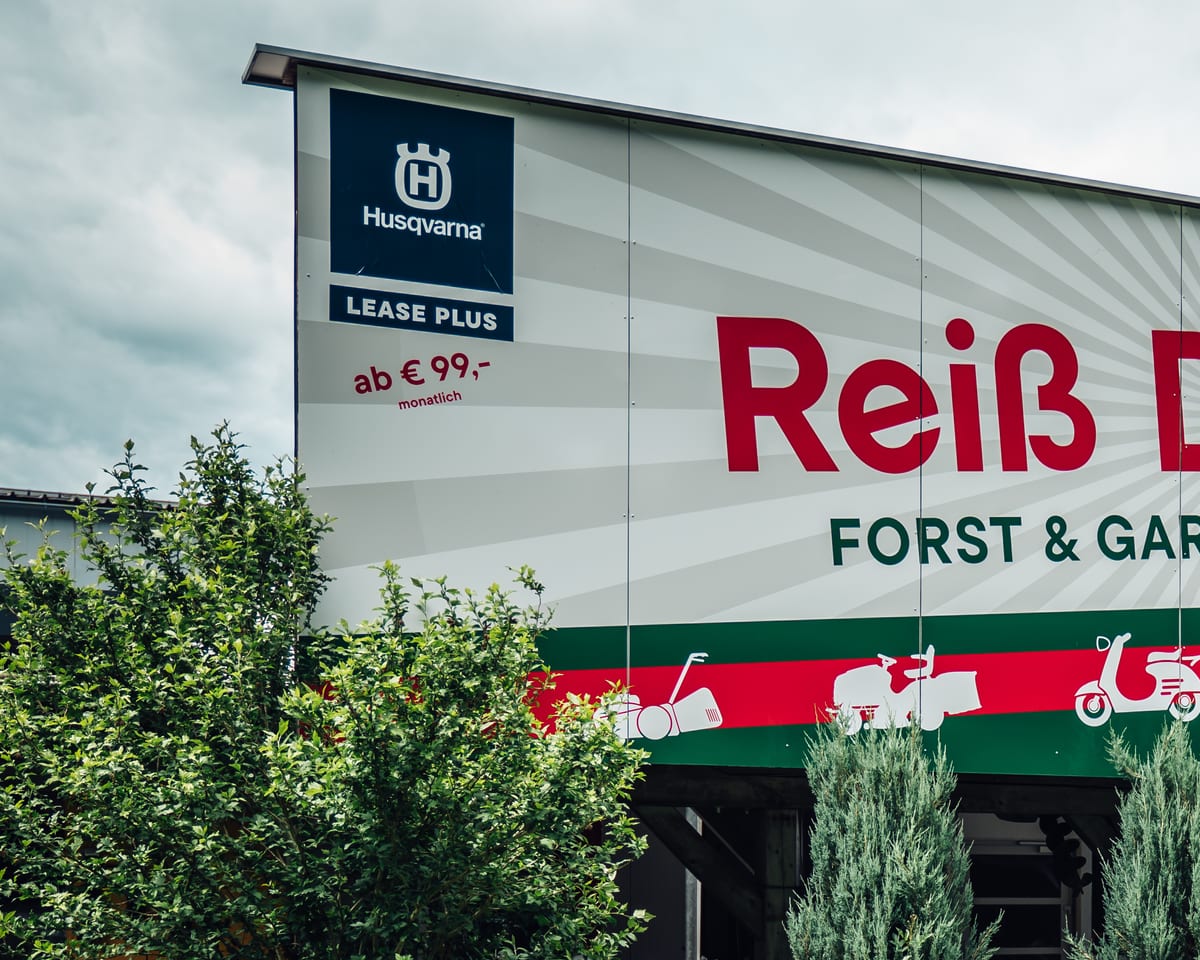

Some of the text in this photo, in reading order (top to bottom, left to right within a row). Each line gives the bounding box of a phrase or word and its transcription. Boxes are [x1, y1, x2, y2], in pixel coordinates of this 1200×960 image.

[410, 163, 437, 198] H
[364, 205, 482, 240] Husqvarna
[347, 296, 498, 331] LEASE PLUS
[353, 366, 392, 394] ab
[400, 359, 425, 385] €
[398, 391, 462, 410] monatlich
[716, 316, 1096, 474] Reiß
[831, 516, 1021, 565] FORST
[1045, 515, 1080, 562] &
